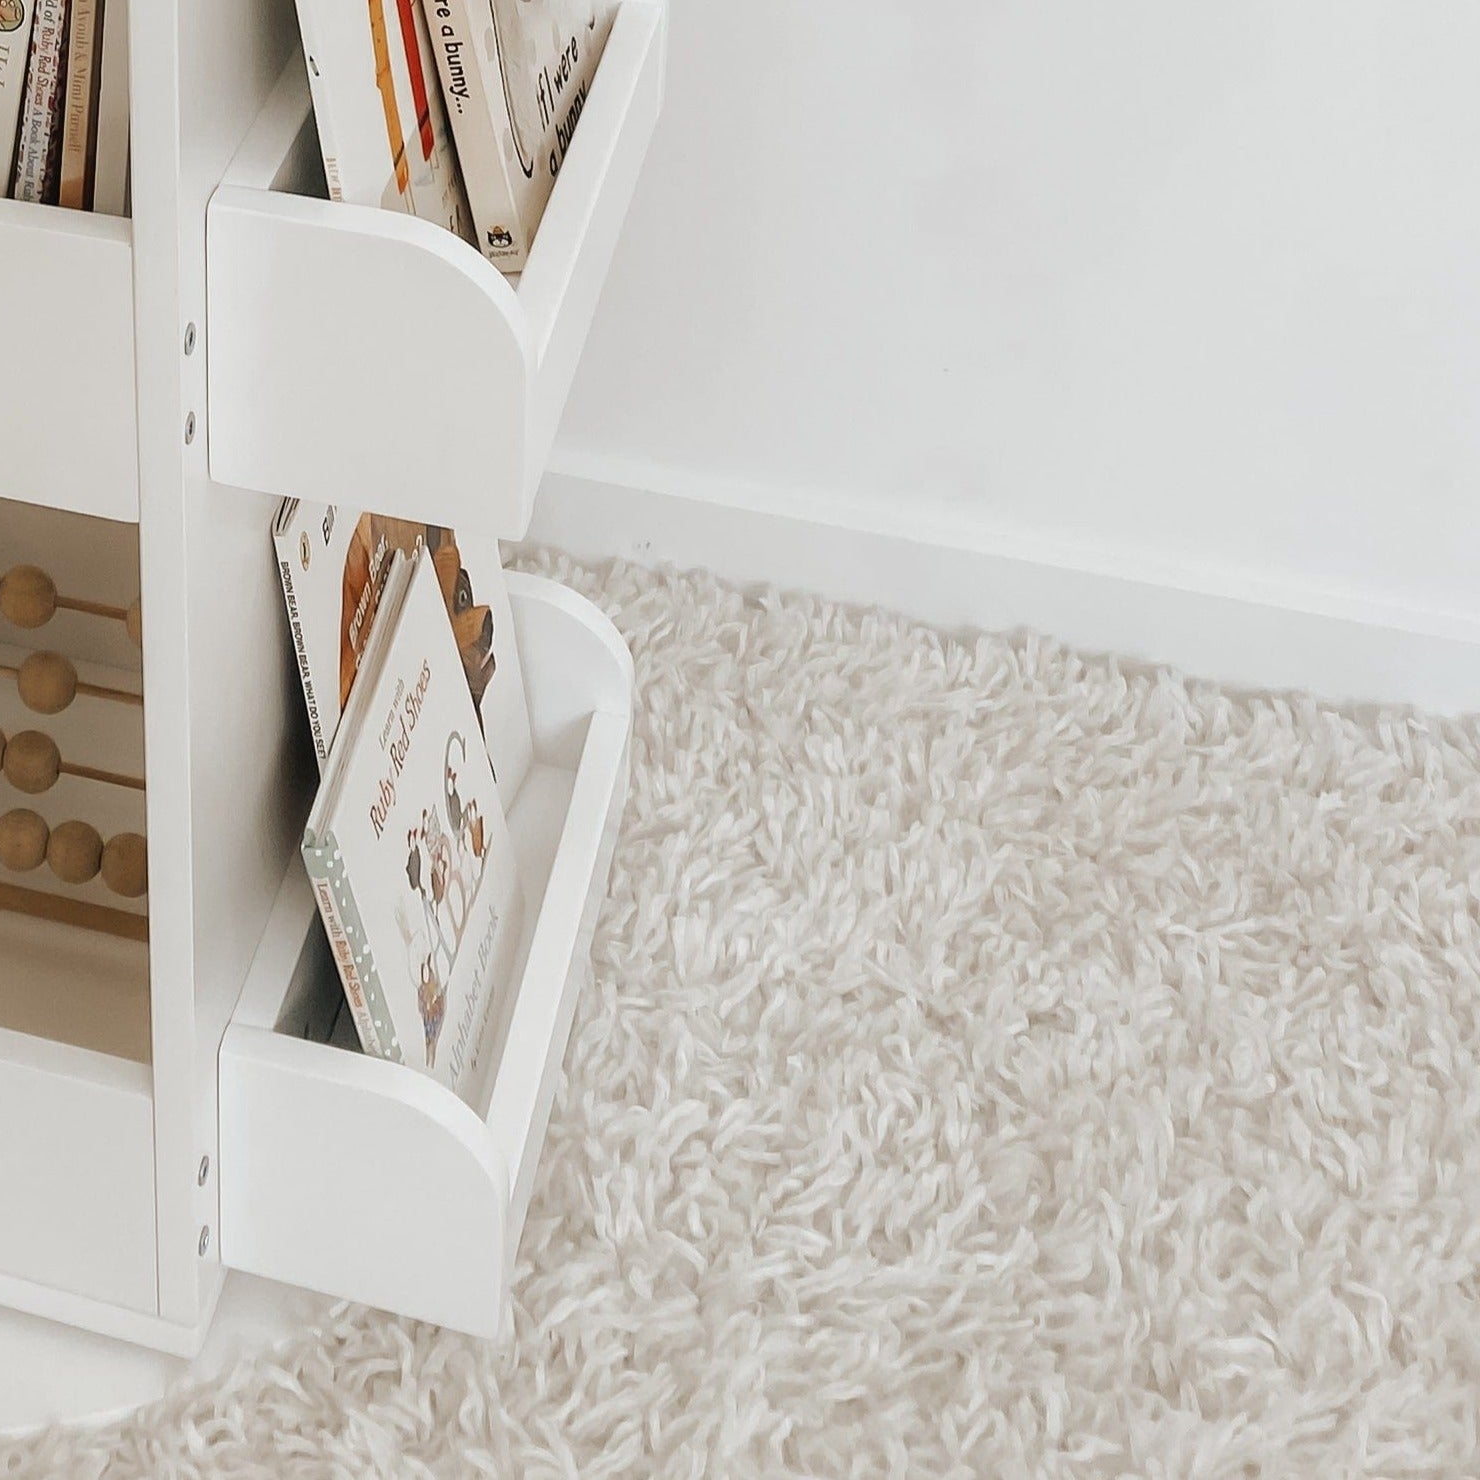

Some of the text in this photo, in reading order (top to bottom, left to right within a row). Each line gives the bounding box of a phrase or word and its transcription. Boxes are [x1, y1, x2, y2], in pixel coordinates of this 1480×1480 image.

[43, 10, 56, 25] of
[441, 25, 455, 37] a
[38, 54, 51, 75] Red
[444, 41, 471, 114] bunny...
[536, 36, 579, 133] If I were
[549, 148, 560, 177] a
[281, 561, 293, 593] BROWN
[349, 581, 371, 651] Brown
[293, 622, 305, 653] BROWN
[305, 681, 316, 705] WHAT
[309, 706, 319, 719] DO
[313, 720, 322, 738] YOU
[379, 708, 395, 751] Learn
[371, 658, 431, 841] Ruby Red Shoes
